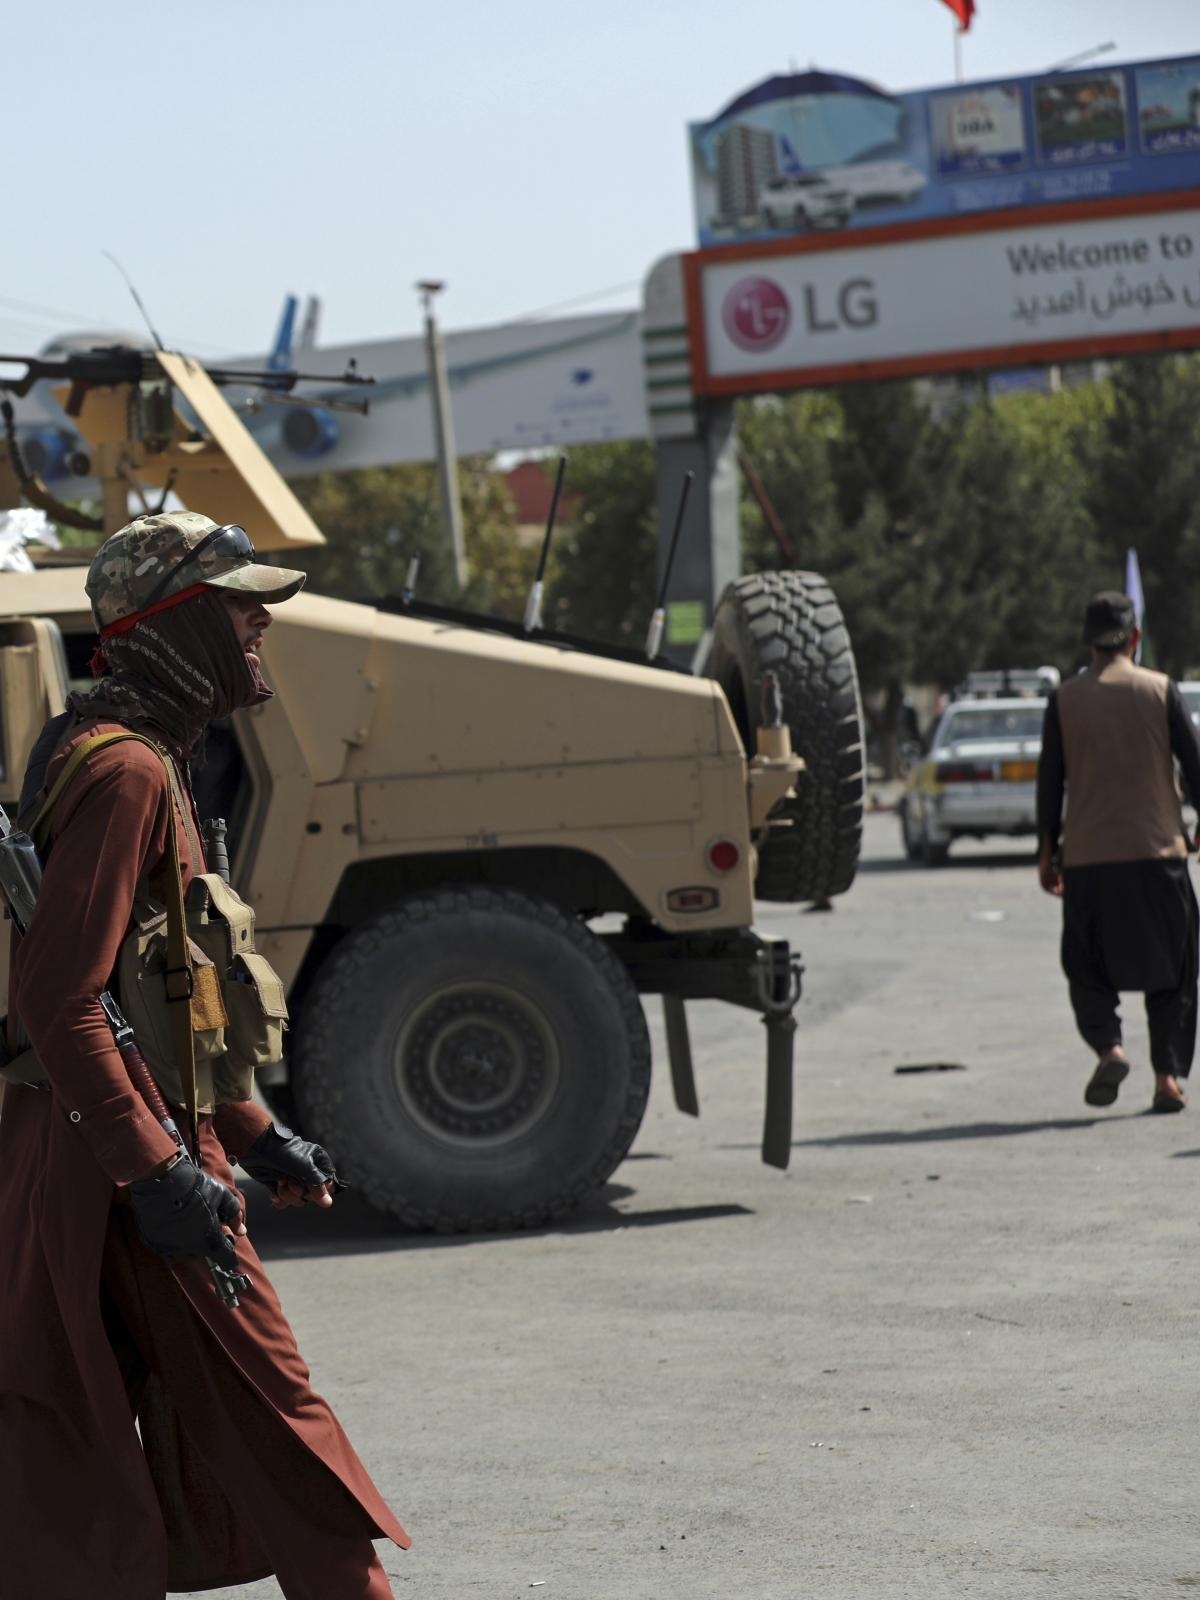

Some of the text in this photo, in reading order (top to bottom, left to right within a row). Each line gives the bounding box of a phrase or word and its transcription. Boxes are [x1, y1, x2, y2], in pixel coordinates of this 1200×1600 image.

[1007, 232, 1193, 276] Welcome to
[803, 277, 879, 334] LG
